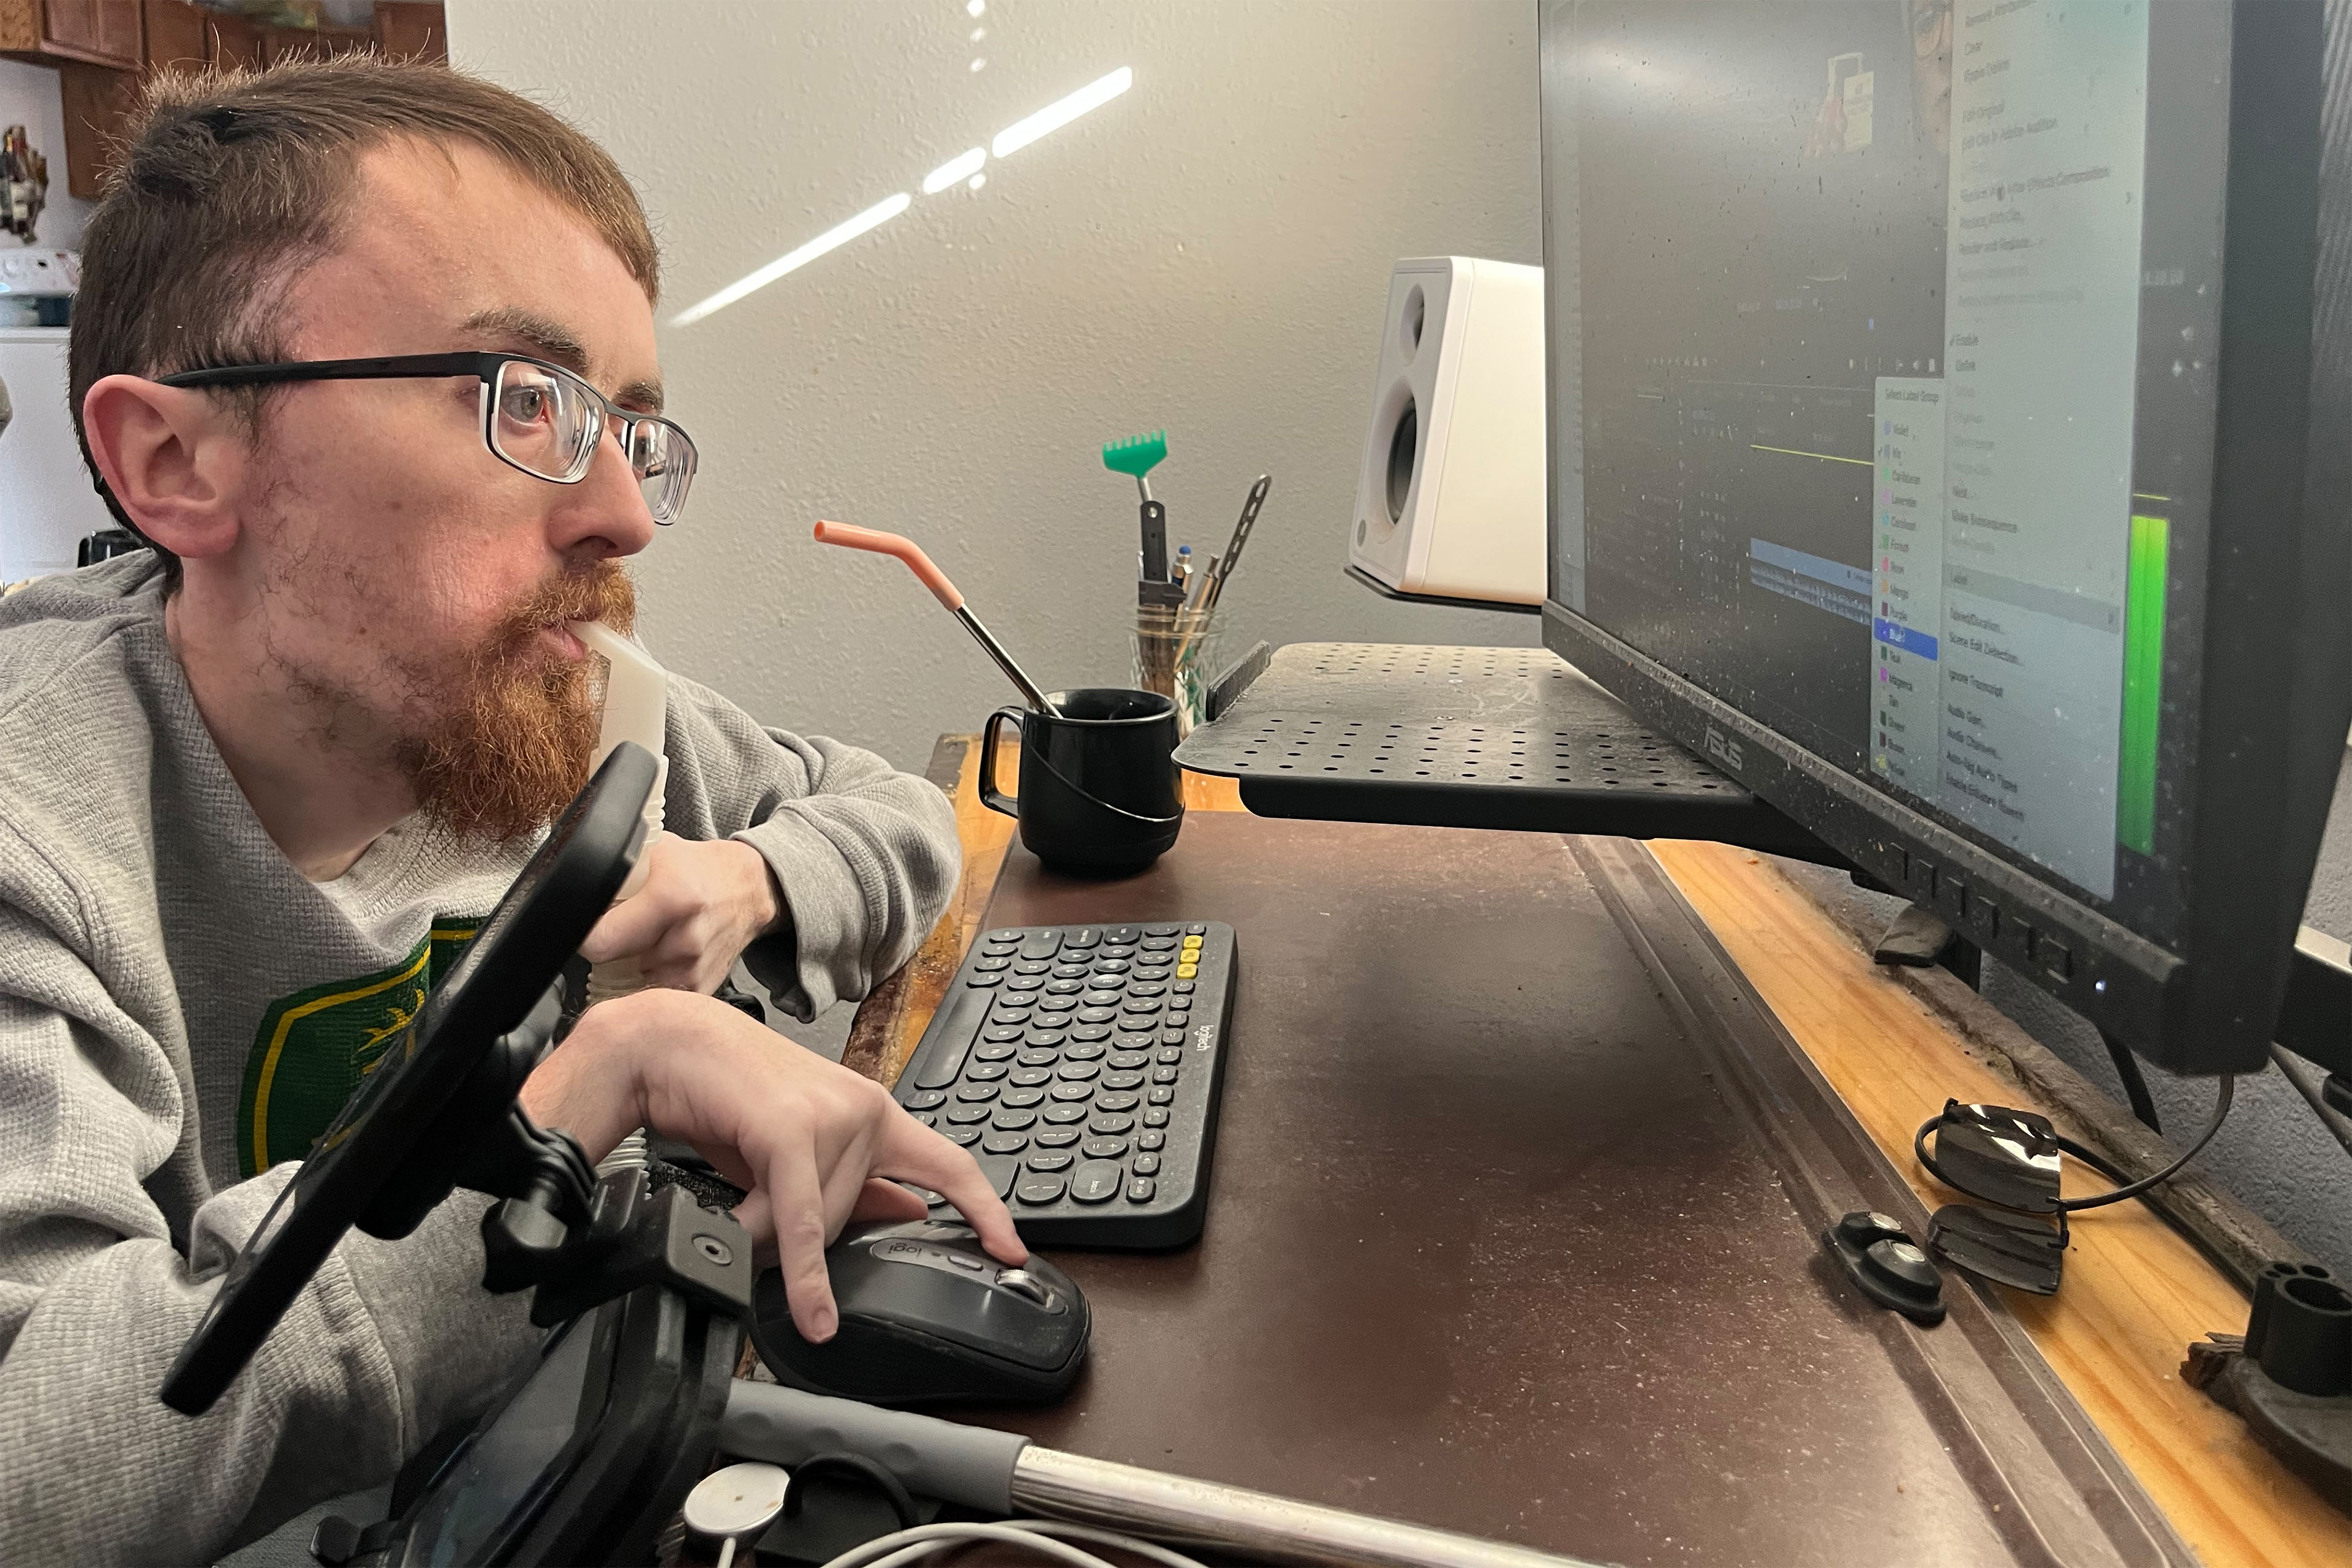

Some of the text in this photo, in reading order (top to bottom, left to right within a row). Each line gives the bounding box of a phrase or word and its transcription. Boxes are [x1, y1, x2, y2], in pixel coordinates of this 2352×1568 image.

[1703, 725, 1743, 771] ASUS
[1194, 1024, 1215, 1051] logitech
[887, 1242, 922, 1257] logi
